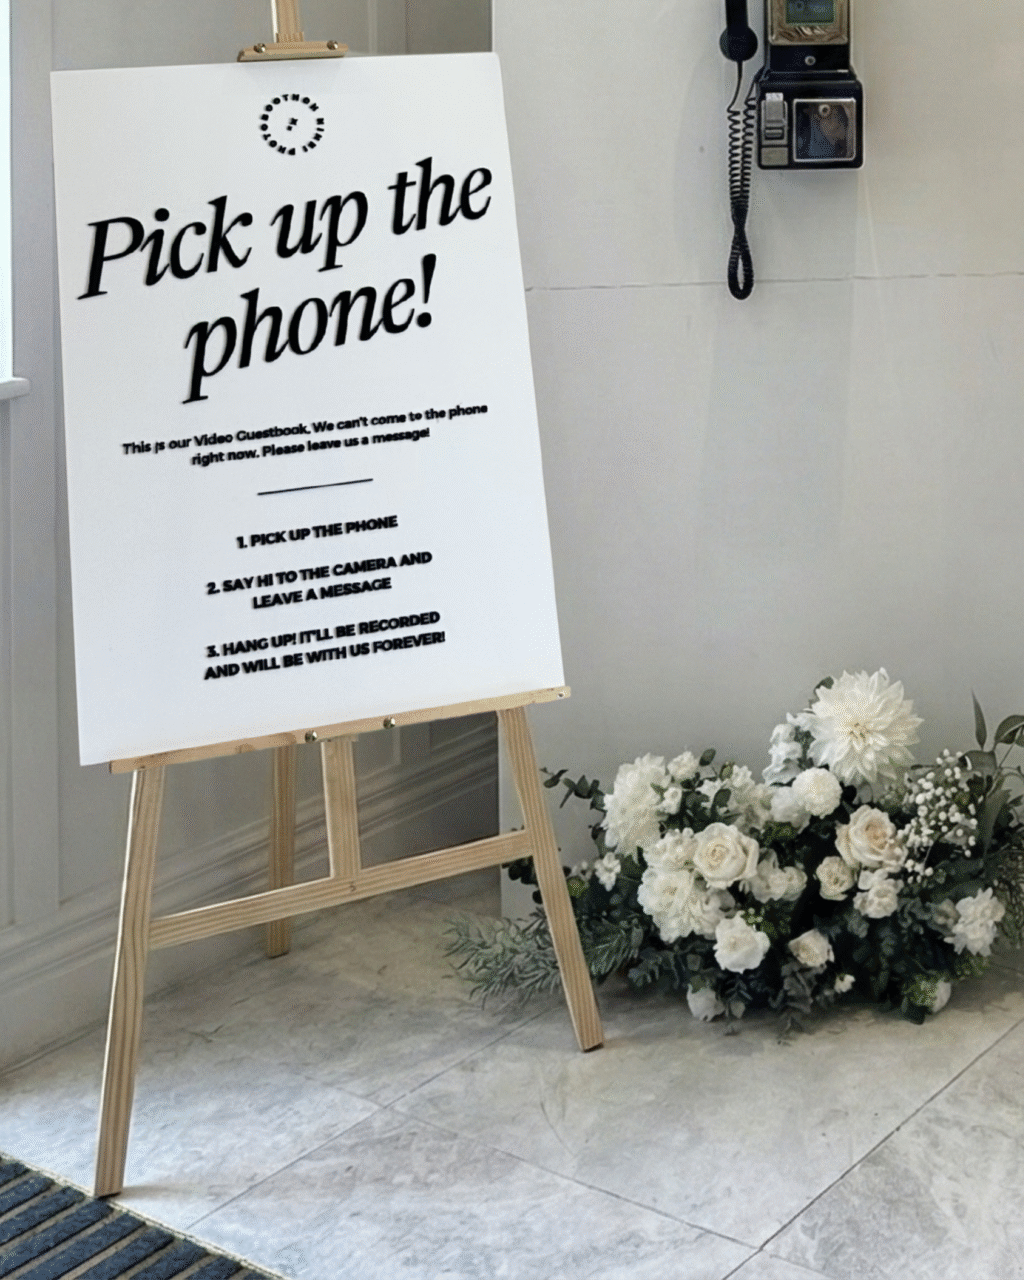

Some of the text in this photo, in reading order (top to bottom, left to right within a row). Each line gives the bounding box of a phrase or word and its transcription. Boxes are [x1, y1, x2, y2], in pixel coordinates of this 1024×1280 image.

[78, 157, 492, 300] Pick up the
[182, 254, 436, 404] phone!
[122, 441, 151, 454] This
[168, 439, 192, 449] our
[194, 433, 233, 446] Video
[236, 423, 311, 441] Guestbook.
[312, 421, 334, 433] We
[336, 417, 368, 430] can't
[370, 415, 406, 425] come
[409, 412, 422, 421] to
[425, 409, 446, 420] the
[449, 405, 488, 420] phone
[192, 428, 430, 467] right now. Please leave us a message!
[237, 515, 398, 549] 1. PICK UP THE PHONE
[207, 552, 432, 595] 2. SAY HI TO THE CAMERA AND
[253, 577, 392, 609] LEAVE A MESSAGE
[204, 631, 445, 680] AND WILL BE WITH US FOREVER!
[207, 611, 440, 658] 3. HANG UP! IT'LL BE RECORDED
